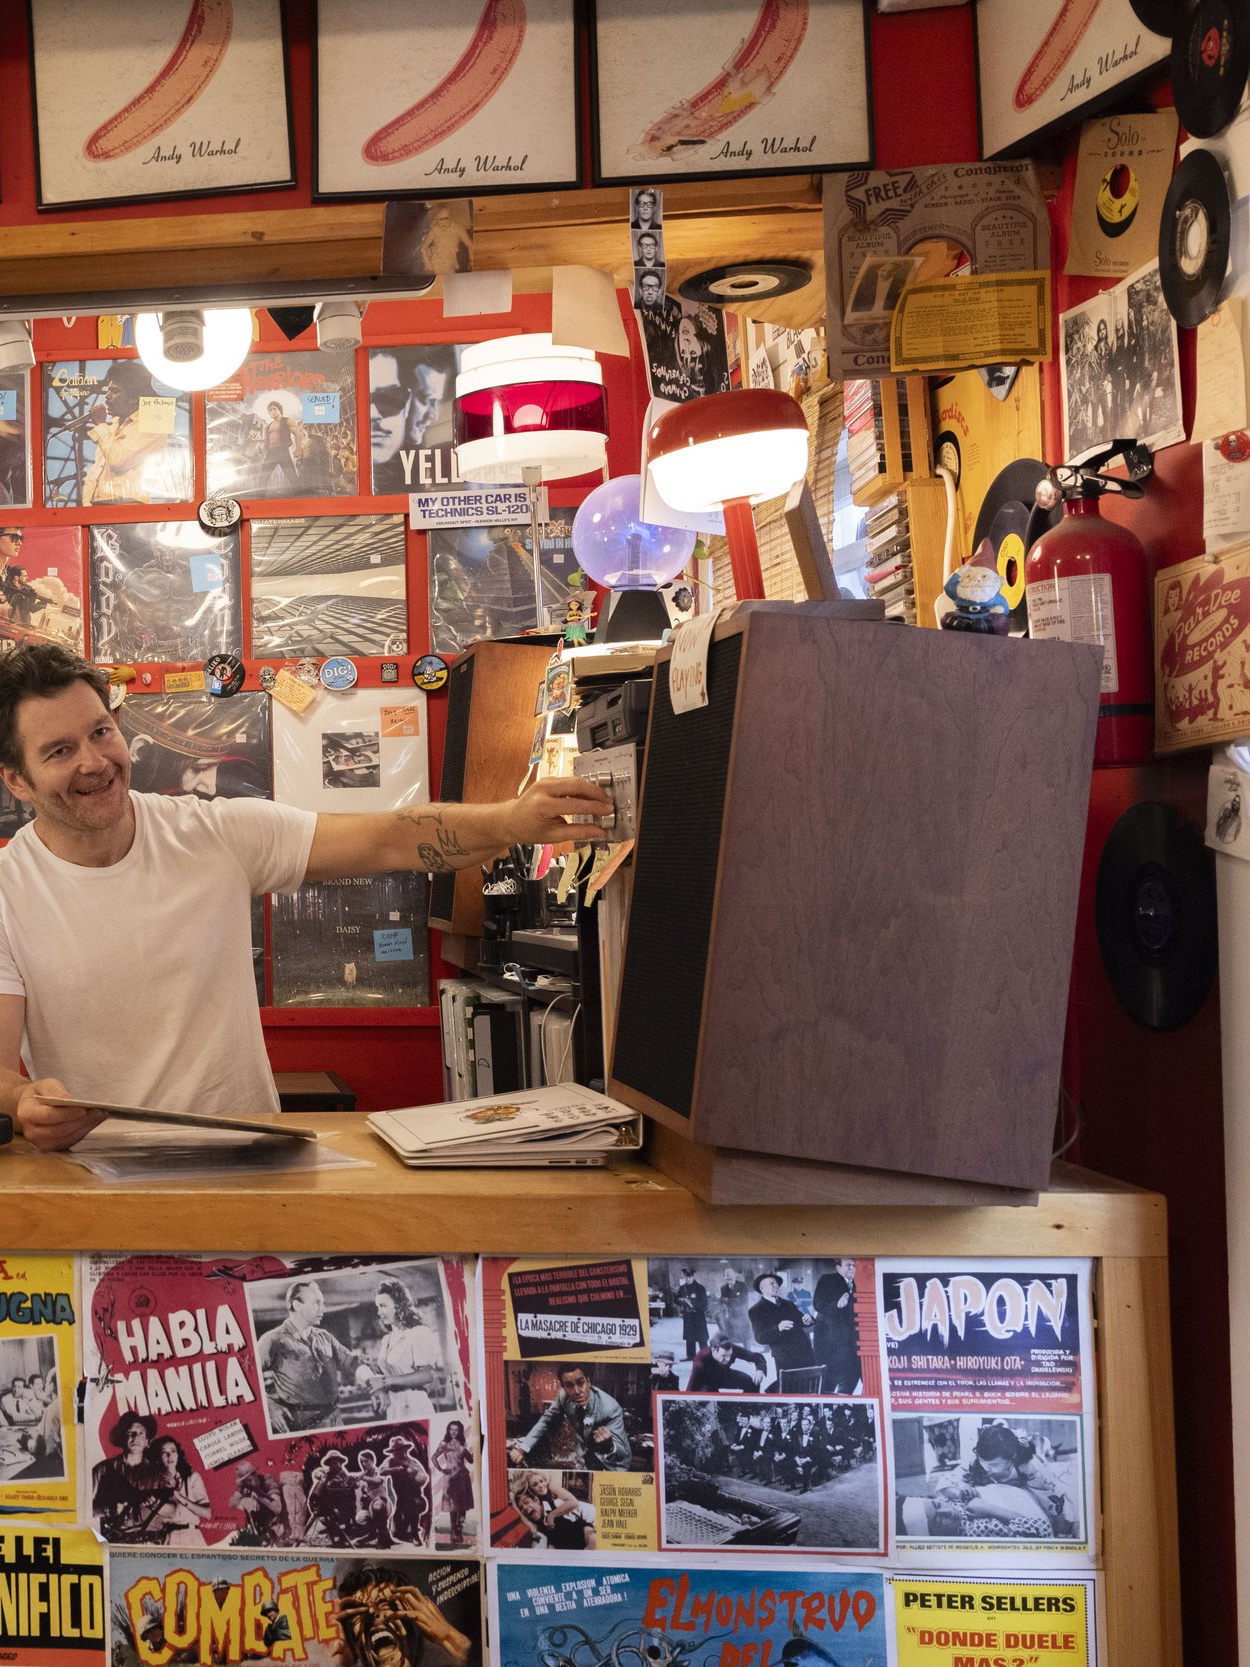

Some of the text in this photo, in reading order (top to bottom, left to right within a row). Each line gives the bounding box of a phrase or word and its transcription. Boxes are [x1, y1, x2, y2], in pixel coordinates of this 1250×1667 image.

[1060, 35, 1141, 101] Andy Warhol
[143, 139, 241, 165] Andy Warhol
[711, 136, 817, 161] Andy Warhol
[424, 155, 528, 178] Andy Warhol
[865, 180, 902, 206] FREE
[418, 493, 527, 507] MY OTHER CAR IS
[420, 506, 484, 519] TECHNICS
[1185, 615, 1239, 663] RECORDS
[324, 664, 353, 678] DIG!
[322, 878, 373, 886] BRAND NEW
[336, 925, 361, 934] DAISY
[883, 1275, 1068, 1343] JAPON
[117, 1304, 247, 1365] HABLA
[519, 1319, 638, 1336] LA MASACRE DE CHICAGO 1929
[911, 1356, 1022, 1370] SHITARA HIROYUKI OTA
[114, 1356, 256, 1418] MANILA
[600, 1486, 642, 1497] JASON ROBARDS
[600, 1497, 635, 1507] GEORGE SEGAL
[600, 1508, 638, 1518] RALPH MEEKER
[601, 1519, 628, 1529] JEAN HALE
[13, 1535, 61, 1564] LEI
[109, 1551, 137, 1559] QUIERE
[138, 1552, 177, 1560] CONOCER
[190, 1553, 238, 1561] ESPANTOSO
[695, 1588, 876, 1634] MONSTRUO
[903, 1592, 1077, 1614] PETER SELLERS
[124, 1564, 342, 1665] COMBATE
[905, 1625, 1078, 1651] "DONDE DUELE
